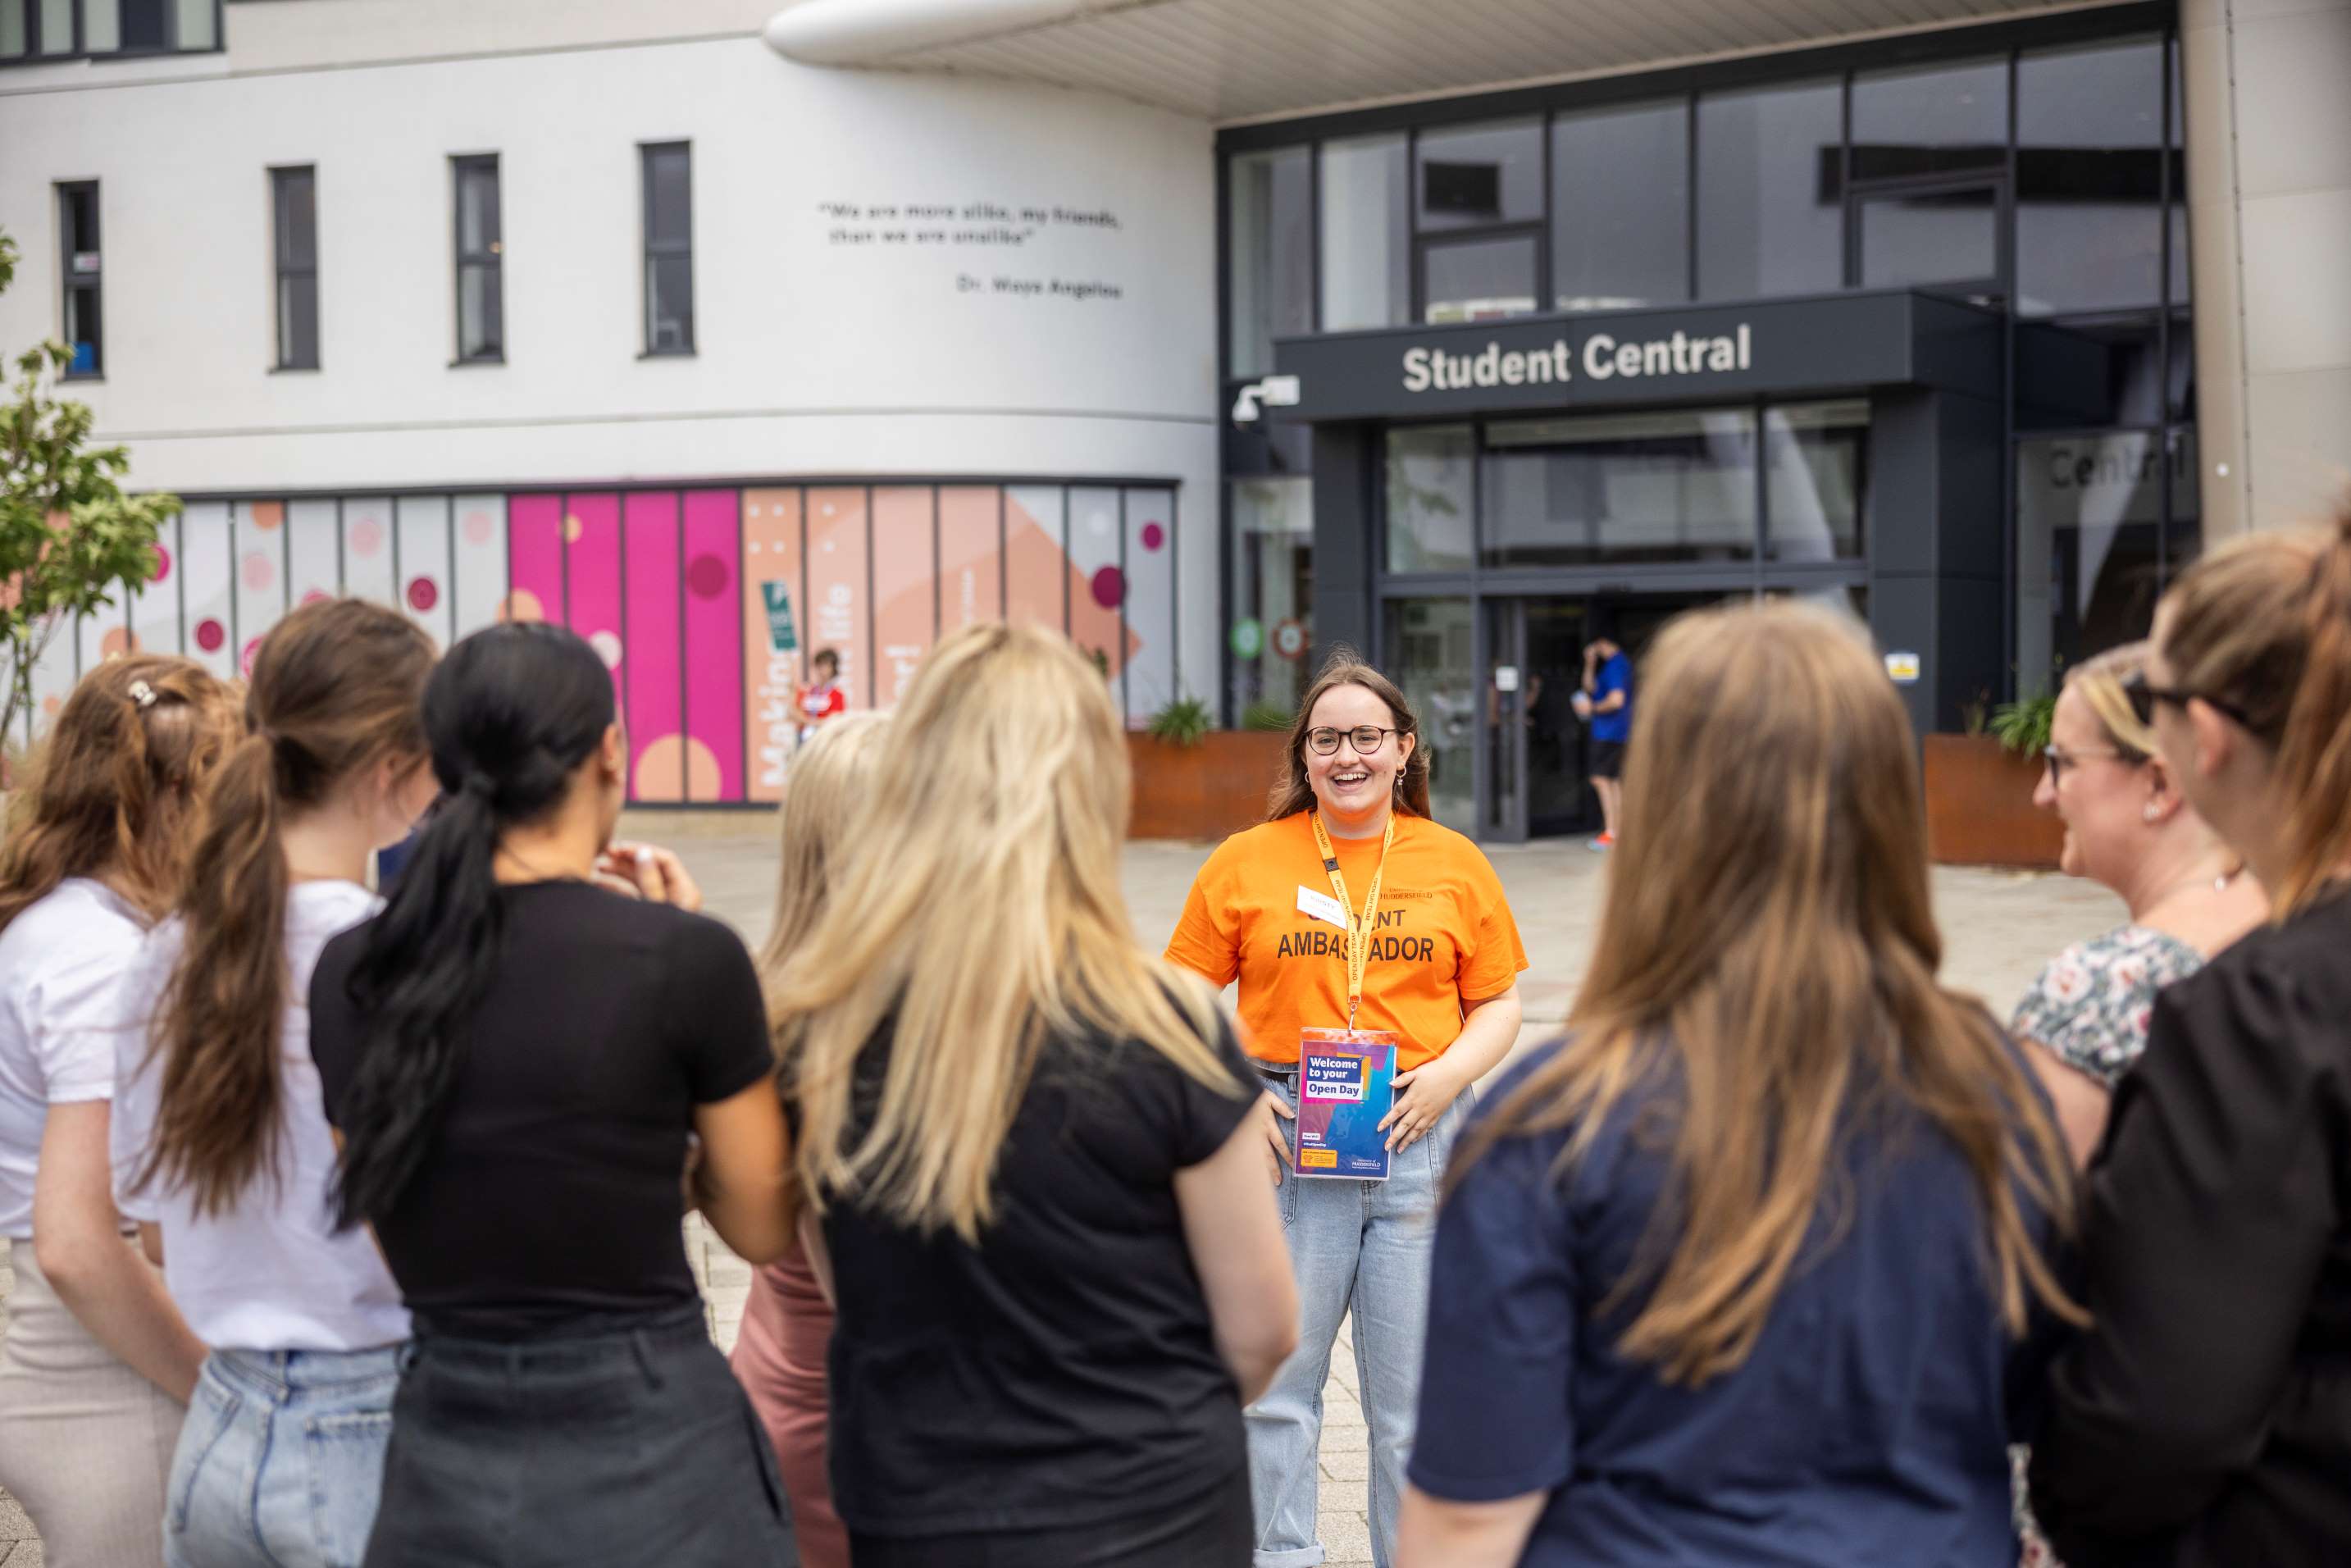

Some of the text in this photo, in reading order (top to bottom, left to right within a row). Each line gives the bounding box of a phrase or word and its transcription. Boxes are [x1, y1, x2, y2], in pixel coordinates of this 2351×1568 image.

[1402, 322, 1752, 392] Student Central
[2051, 435, 2185, 489] Centrl
[1277, 932, 1434, 963] AMBASADOR
[1309, 1068, 1348, 1080] to your
[1310, 1057, 1358, 1069] Welcome
[1309, 1083, 1360, 1097] Open Day
